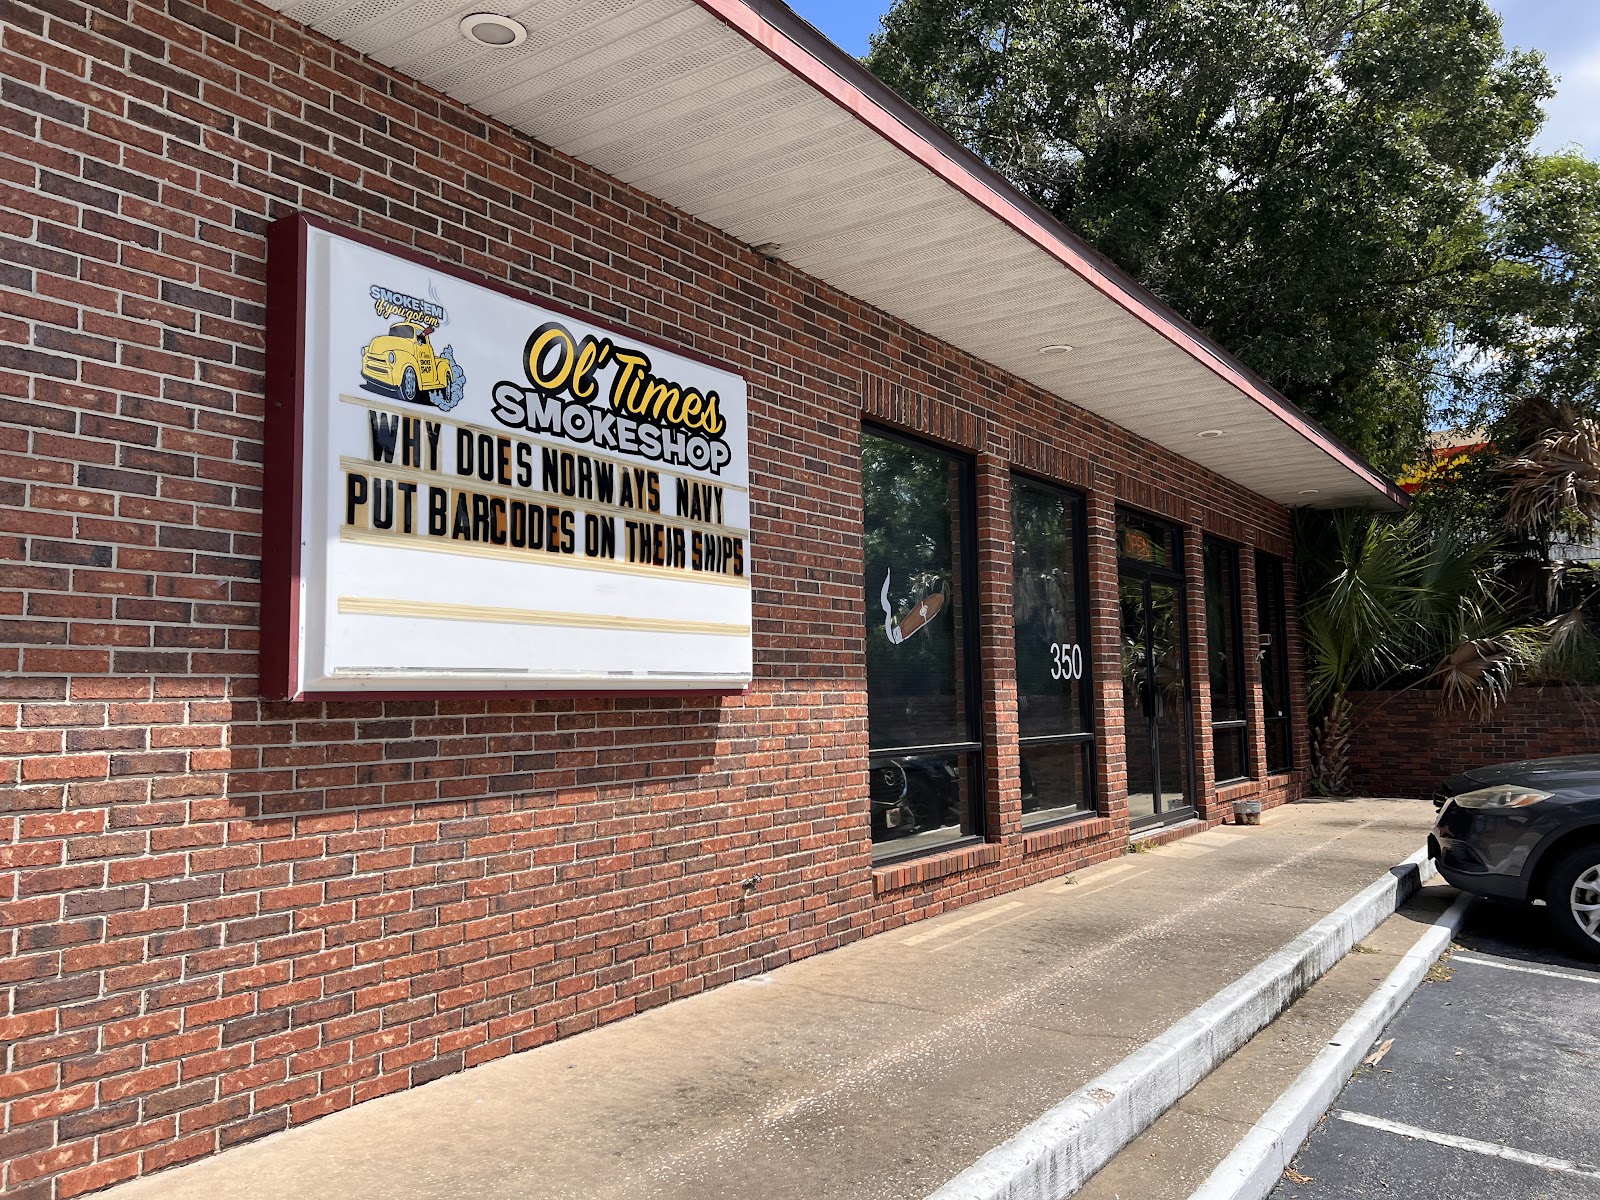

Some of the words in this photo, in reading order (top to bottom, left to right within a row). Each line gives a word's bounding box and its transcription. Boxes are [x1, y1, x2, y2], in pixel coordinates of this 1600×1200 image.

[383, 301, 407, 320] you
[523, 321, 614, 404] Ol'
[609, 345, 726, 438] Times
[369, 410, 441, 470] WHY
[457, 427, 532, 488] DOES
[542, 446, 660, 512] NORWAYS
[676, 477, 723, 525] NAVY
[490, 380, 731, 475] SMOKESHOP
[347, 473, 417, 533] PUT
[428, 487, 576, 554] BARCODES
[585, 513, 616, 559] ON
[625, 520, 686, 569] THEIR
[692, 530, 744, 576] SHIPS
[1126, 533, 1151, 557] OPEN
[1050, 642, 1083, 680] 350
